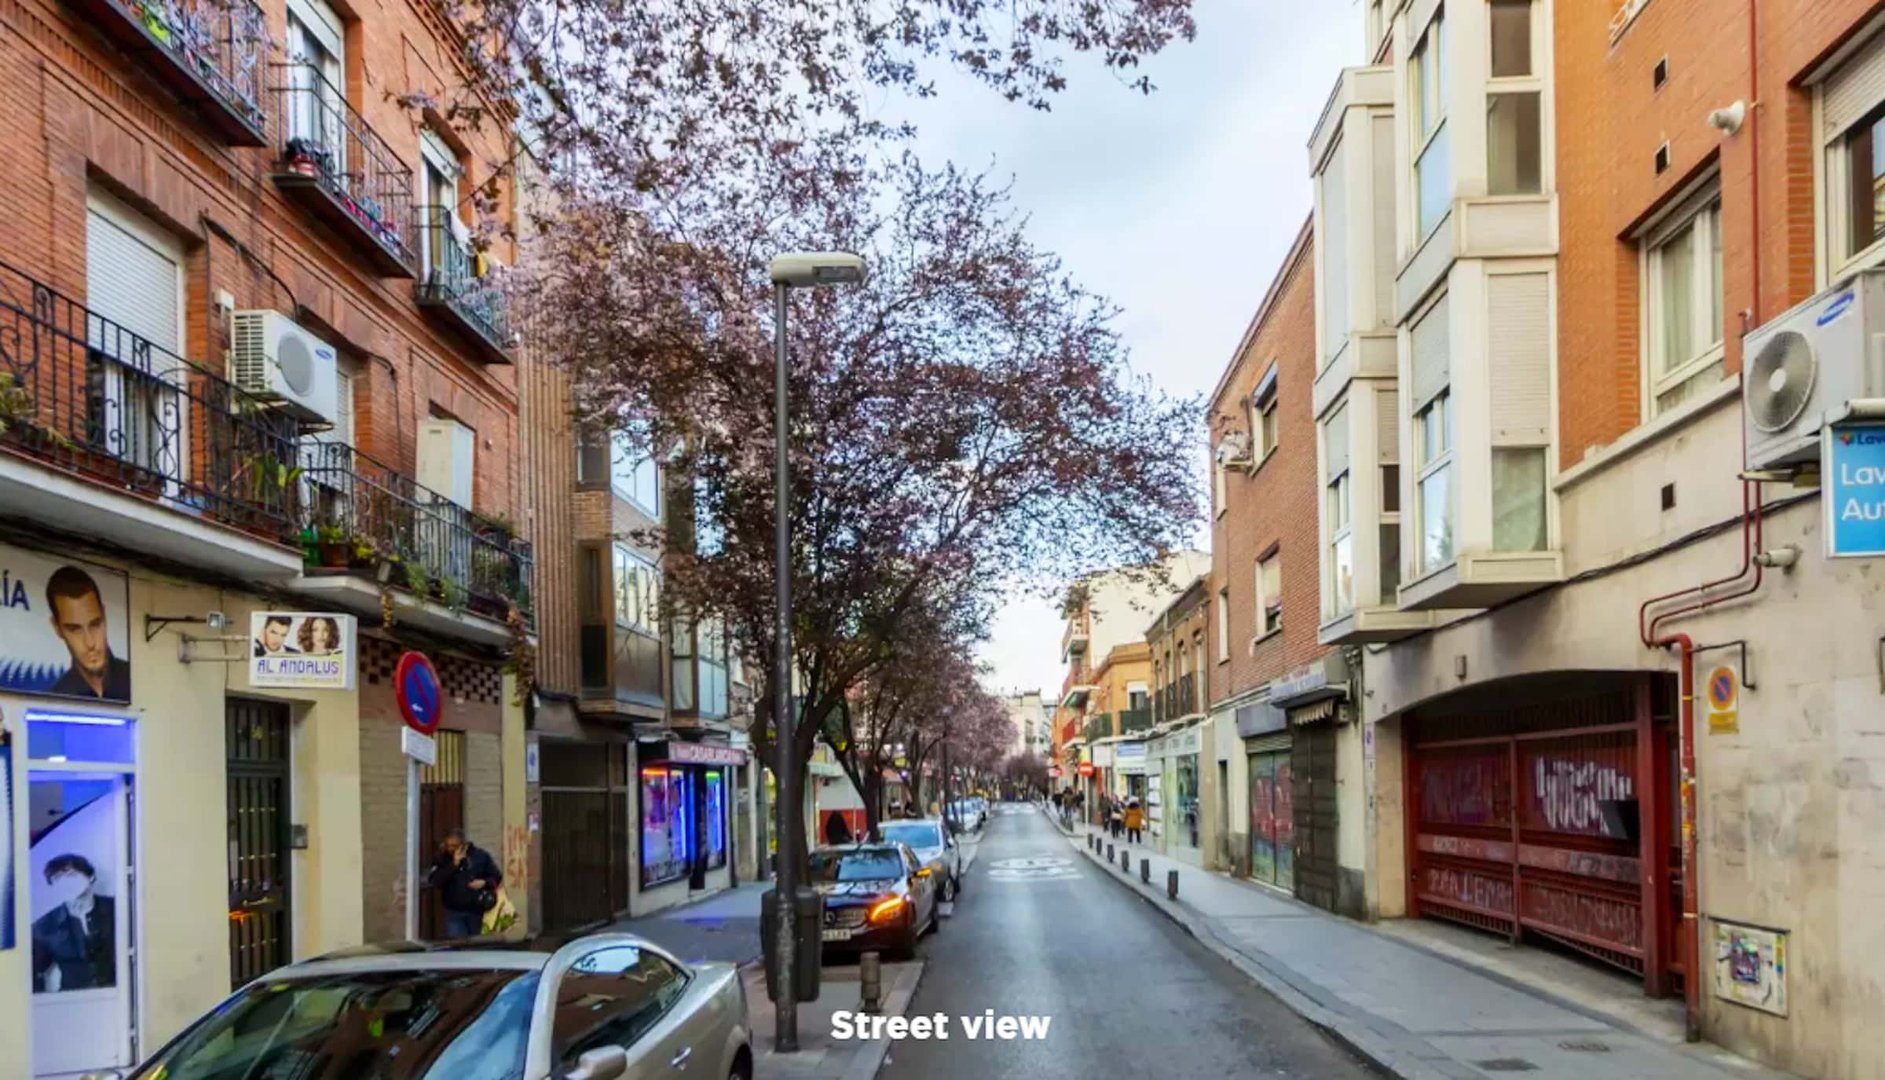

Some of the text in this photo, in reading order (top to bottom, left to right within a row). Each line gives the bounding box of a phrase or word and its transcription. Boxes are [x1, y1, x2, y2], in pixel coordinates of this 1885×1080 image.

[1841, 498, 1885, 521] Au
[0, 569, 31, 611] ÍA
[257, 659, 340, 675] AL ANDALUS
